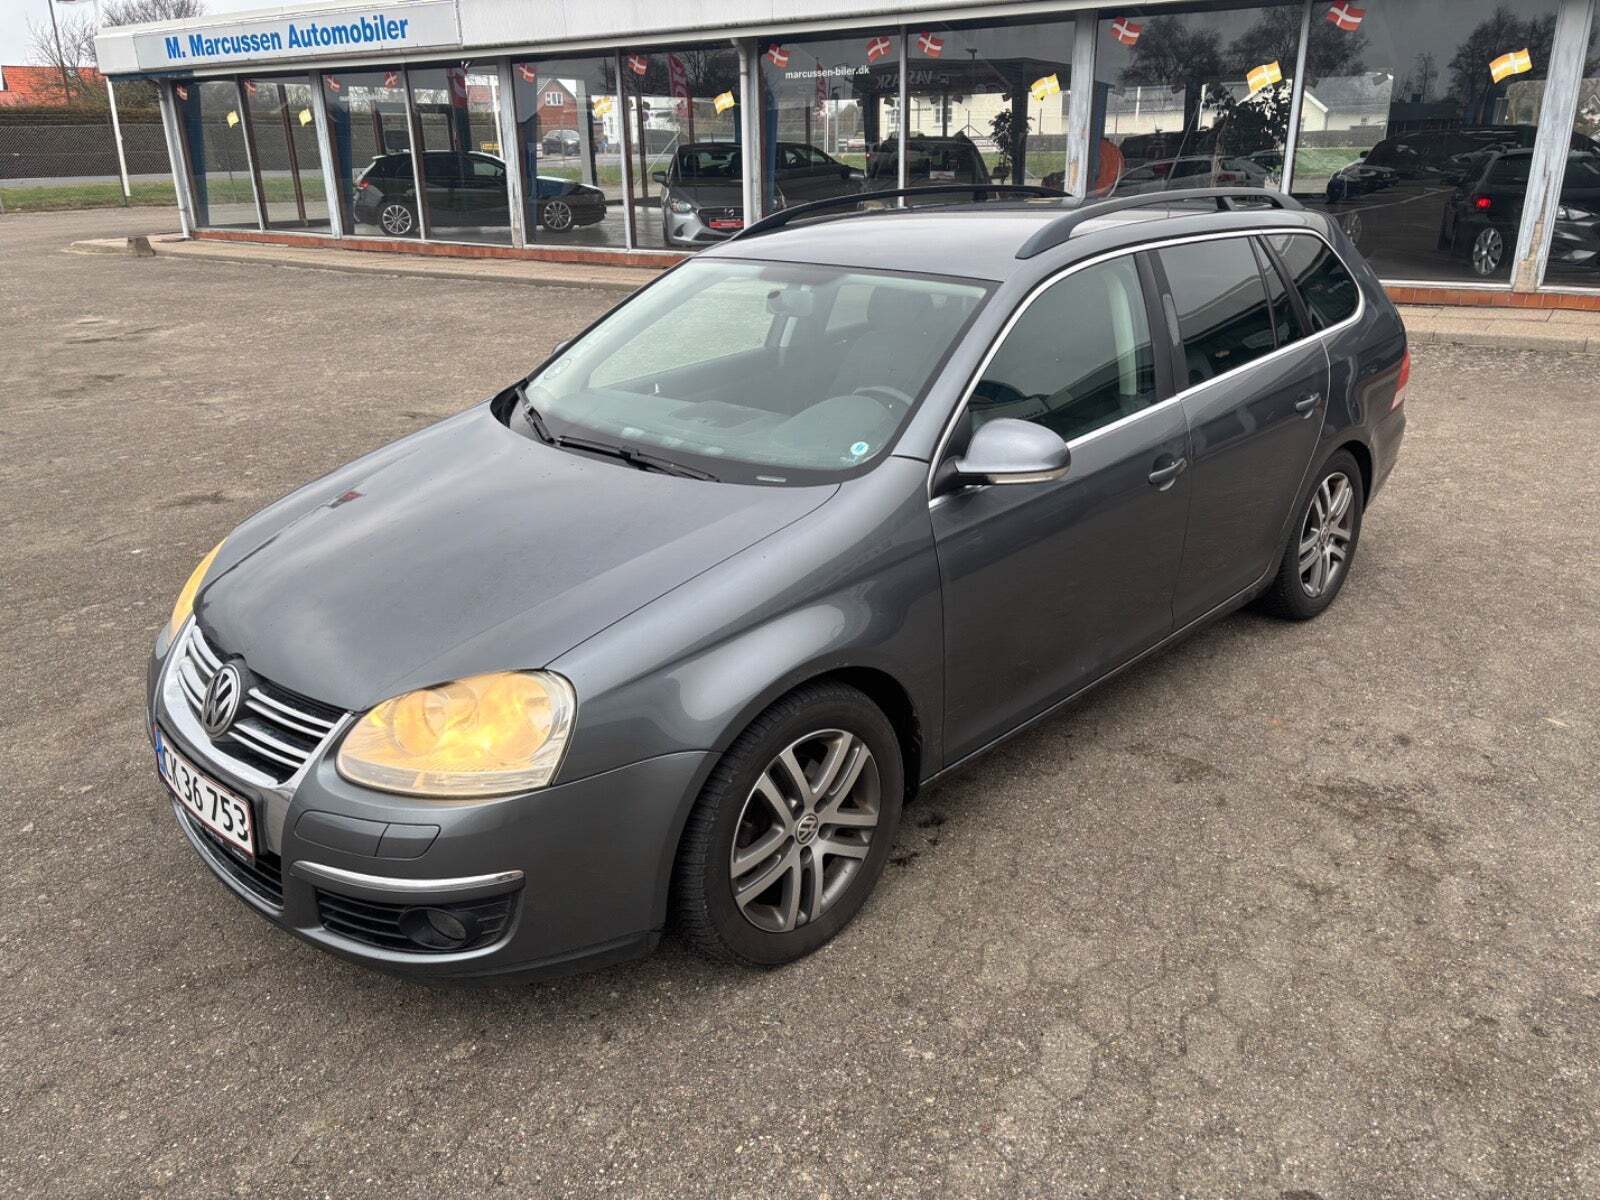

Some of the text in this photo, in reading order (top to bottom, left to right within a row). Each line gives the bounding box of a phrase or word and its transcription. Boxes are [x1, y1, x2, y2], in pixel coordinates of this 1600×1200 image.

[165, 15, 410, 59] M. Marcussen Automobiler
[785, 65, 869, 79] marcussen-biler.dk
[181, 766, 203, 812] 36
[206, 786, 249, 842] 753
